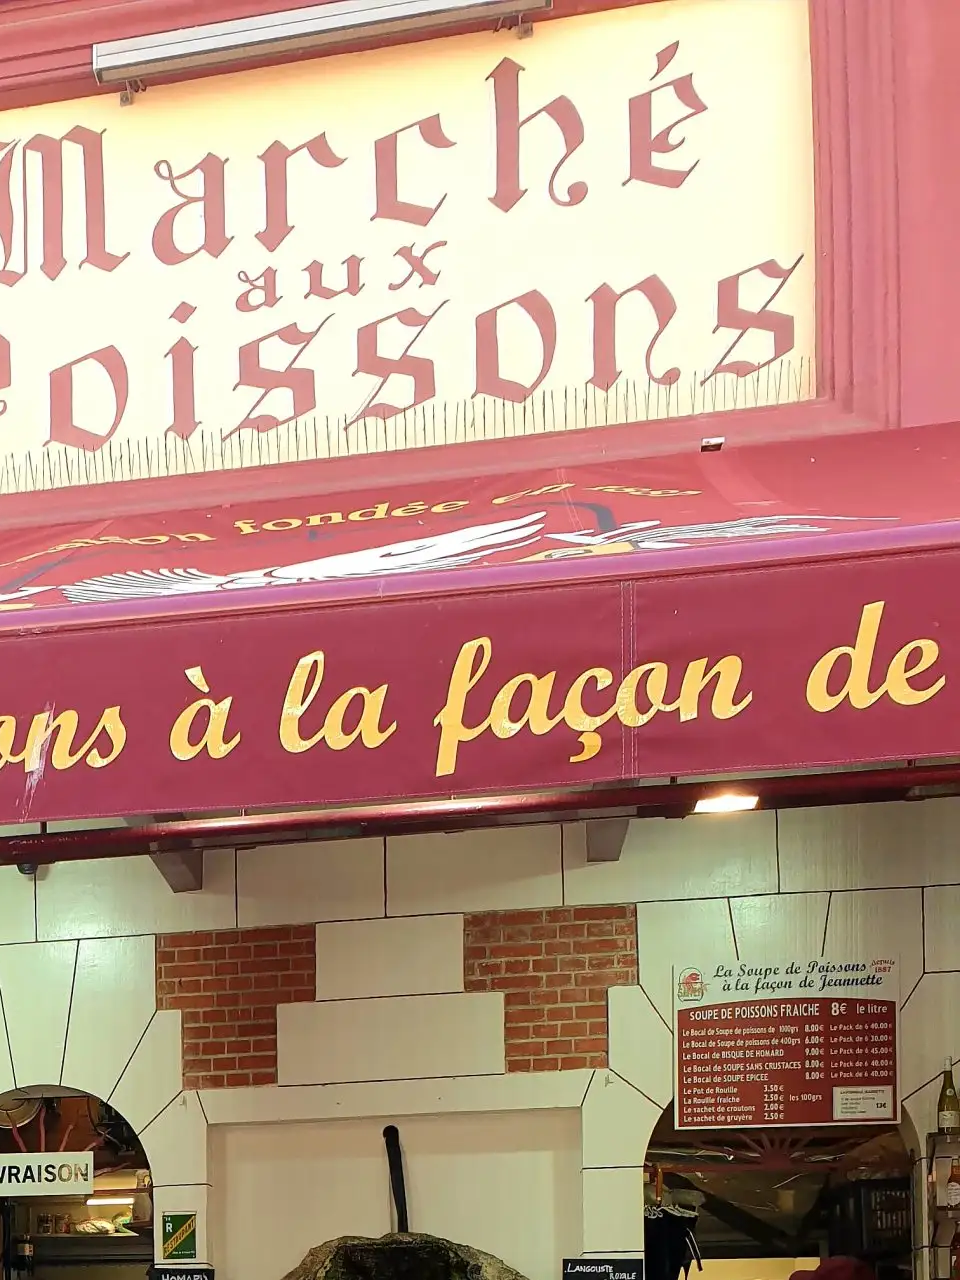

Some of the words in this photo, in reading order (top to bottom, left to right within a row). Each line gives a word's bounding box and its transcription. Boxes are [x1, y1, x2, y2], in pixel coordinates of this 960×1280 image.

[234, 240, 448, 313] aux
[233, 498, 470, 536] fondée
[492, 482, 576, 505] en
[169, 665, 241, 760] à
[278, 650, 398, 754] la
[433, 635, 754, 777] façon
[805, 599, 948, 715] de
[714, 965, 733, 978] La
[738, 964, 780, 980] Soupe
[786, 962, 801, 975] de
[807, 960, 867, 974] Poissons
[722, 980, 731, 992] à
[735, 978, 750, 991] la
[752, 978, 792, 995] façon
[799, 976, 815, 988] de
[818, 974, 884, 992] Jeannette
[689, 1009, 719, 1020] SOUPE
[721, 1008, 733, 1019] DE
[735, 1005, 778, 1018] POISSONS
[780, 1003, 820, 1017] FRAICHE
[856, 1003, 865, 1014] le
[868, 1003, 888, 1014] litre
[682, 1029, 690, 1037] Le
[690, 1028, 706, 1036] Bocal
[707, 1028, 715, 1036] de
[715, 1027, 733, 1036] Soupe
[734, 1027, 741, 1035] de
[742, 1026, 767, 1036] poissons
[682, 1041, 690, 1049] Le
[691, 1040, 707, 1048] Bocal
[717, 1039, 735, 1048] Soupe
[745, 1039, 770, 1047] poissons
[692, 1052, 710, 1060] Bocal
[711, 1051, 720, 1059] de
[721, 1051, 744, 1060] BISQUE
[755, 1049, 784, 1057] HOMARD
[683, 1065, 692, 1073] Le
[713, 1064, 721, 1072] de
[723, 1063, 744, 1072] SOUPE
[746, 1063, 763, 1071] SANS
[764, 1062, 801, 1070] CRUSTACES
[683, 1076, 692, 1084] Le
[693, 1076, 711, 1084] Bocal
[713, 1075, 722, 1083] de
[723, 1074, 745, 1082] SOUPE
[165, 1222, 173, 1233] R
[567, 1262, 614, 1273] LANGOUSTE
[609, 1272, 637, 1280] ROYALE
